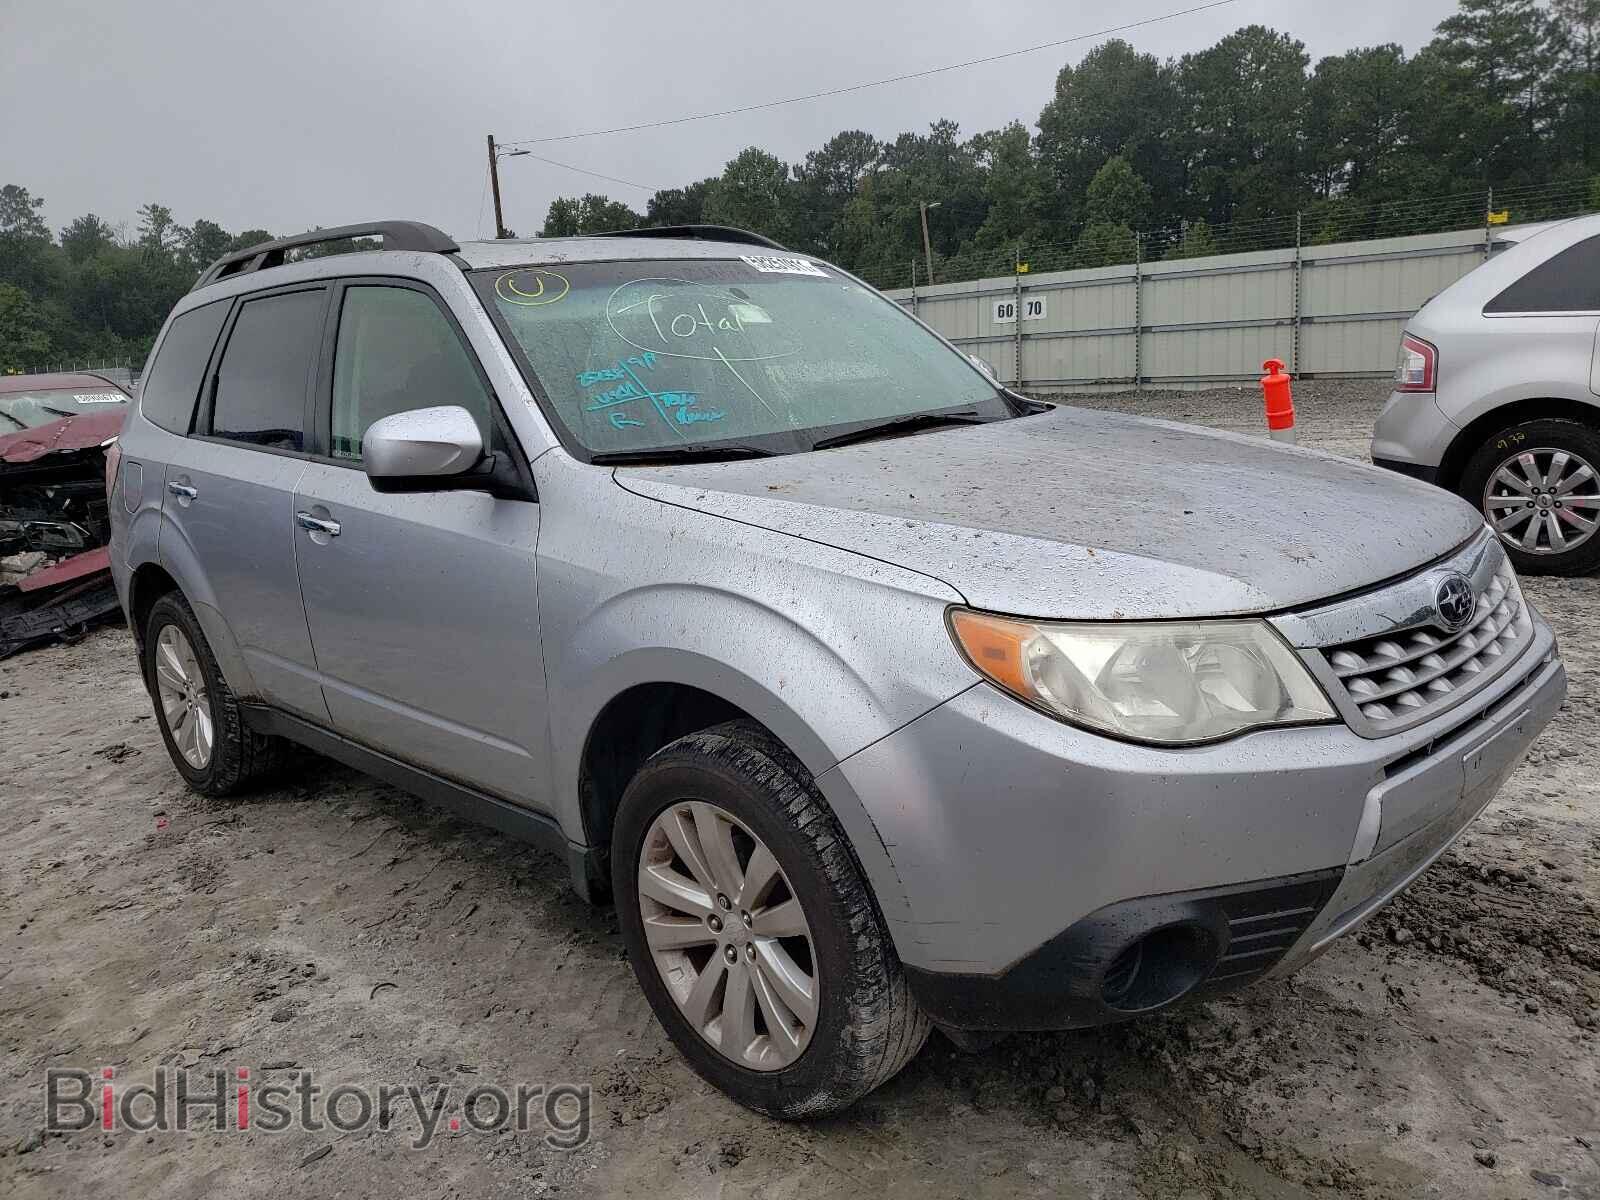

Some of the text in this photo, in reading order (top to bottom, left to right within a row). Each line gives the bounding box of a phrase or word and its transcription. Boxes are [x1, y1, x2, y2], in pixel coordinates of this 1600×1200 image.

[997, 303, 1014, 318] 60
[1027, 300, 1042, 316] 70
[616, 294, 746, 344] Total
